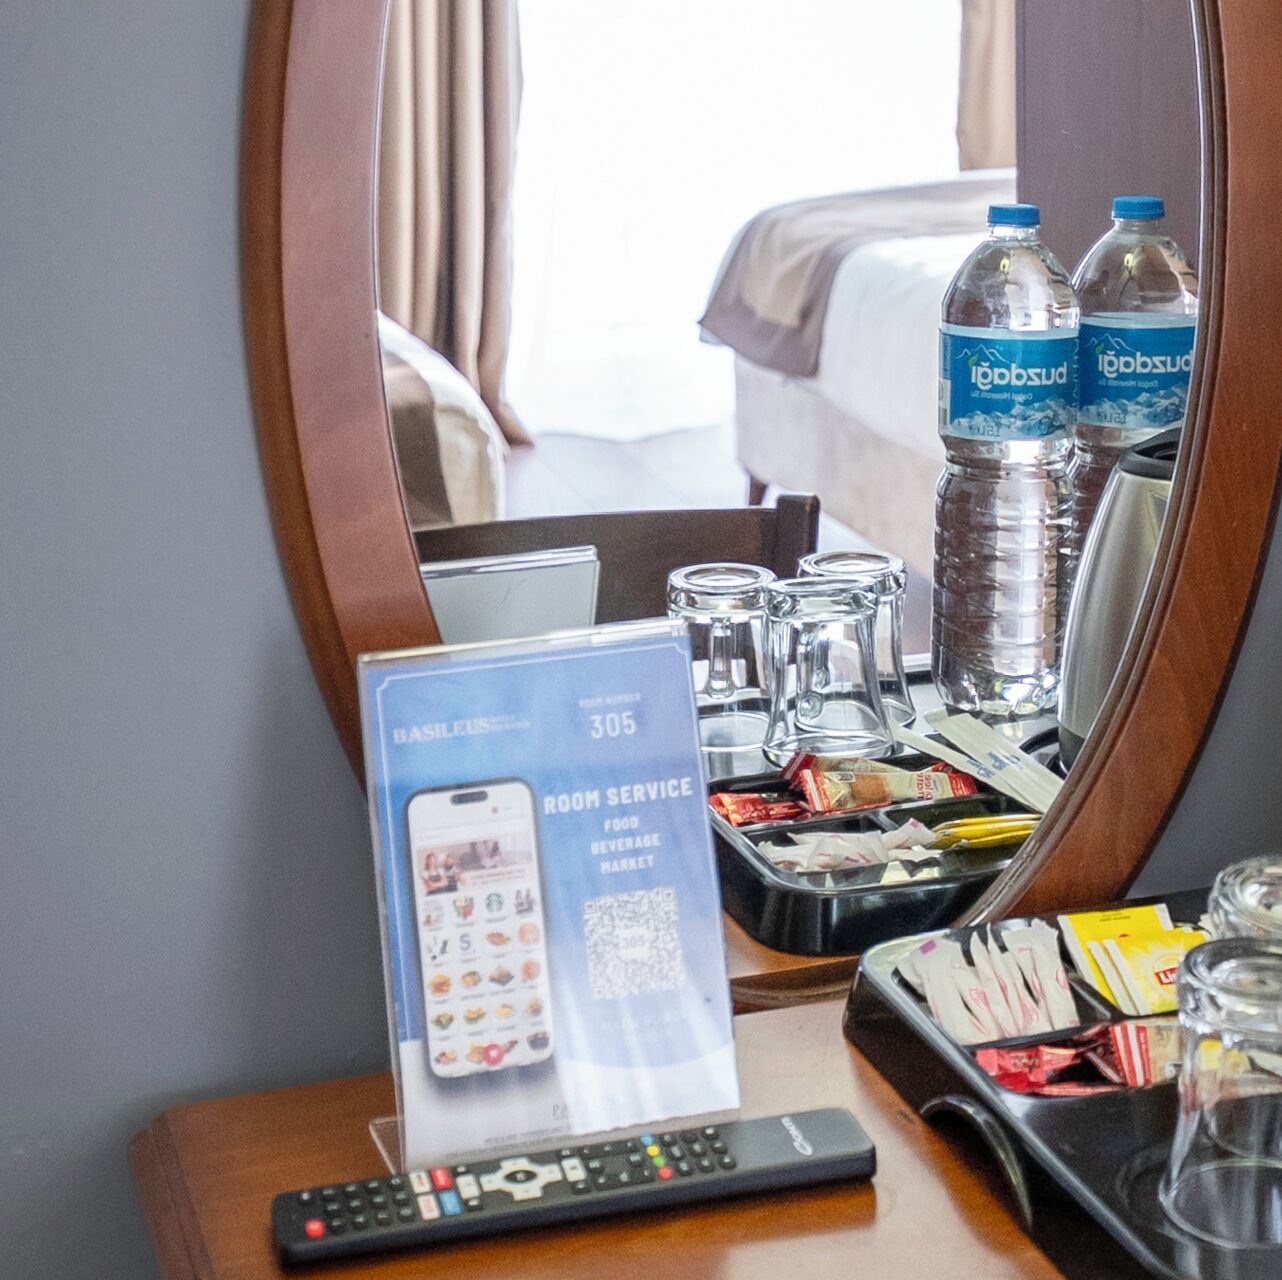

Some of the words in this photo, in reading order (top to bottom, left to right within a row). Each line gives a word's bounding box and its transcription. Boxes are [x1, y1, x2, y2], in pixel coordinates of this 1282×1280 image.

[392, 719, 490, 744] BASILEUS
[590, 711, 637, 740] 305
[544, 791, 601, 815] ROOM
[607, 777, 693, 807] SERVICE
[604, 816, 639, 833] FOOD
[591, 833, 661, 856] BEVERAGE
[601, 855, 655, 875] MARKET
